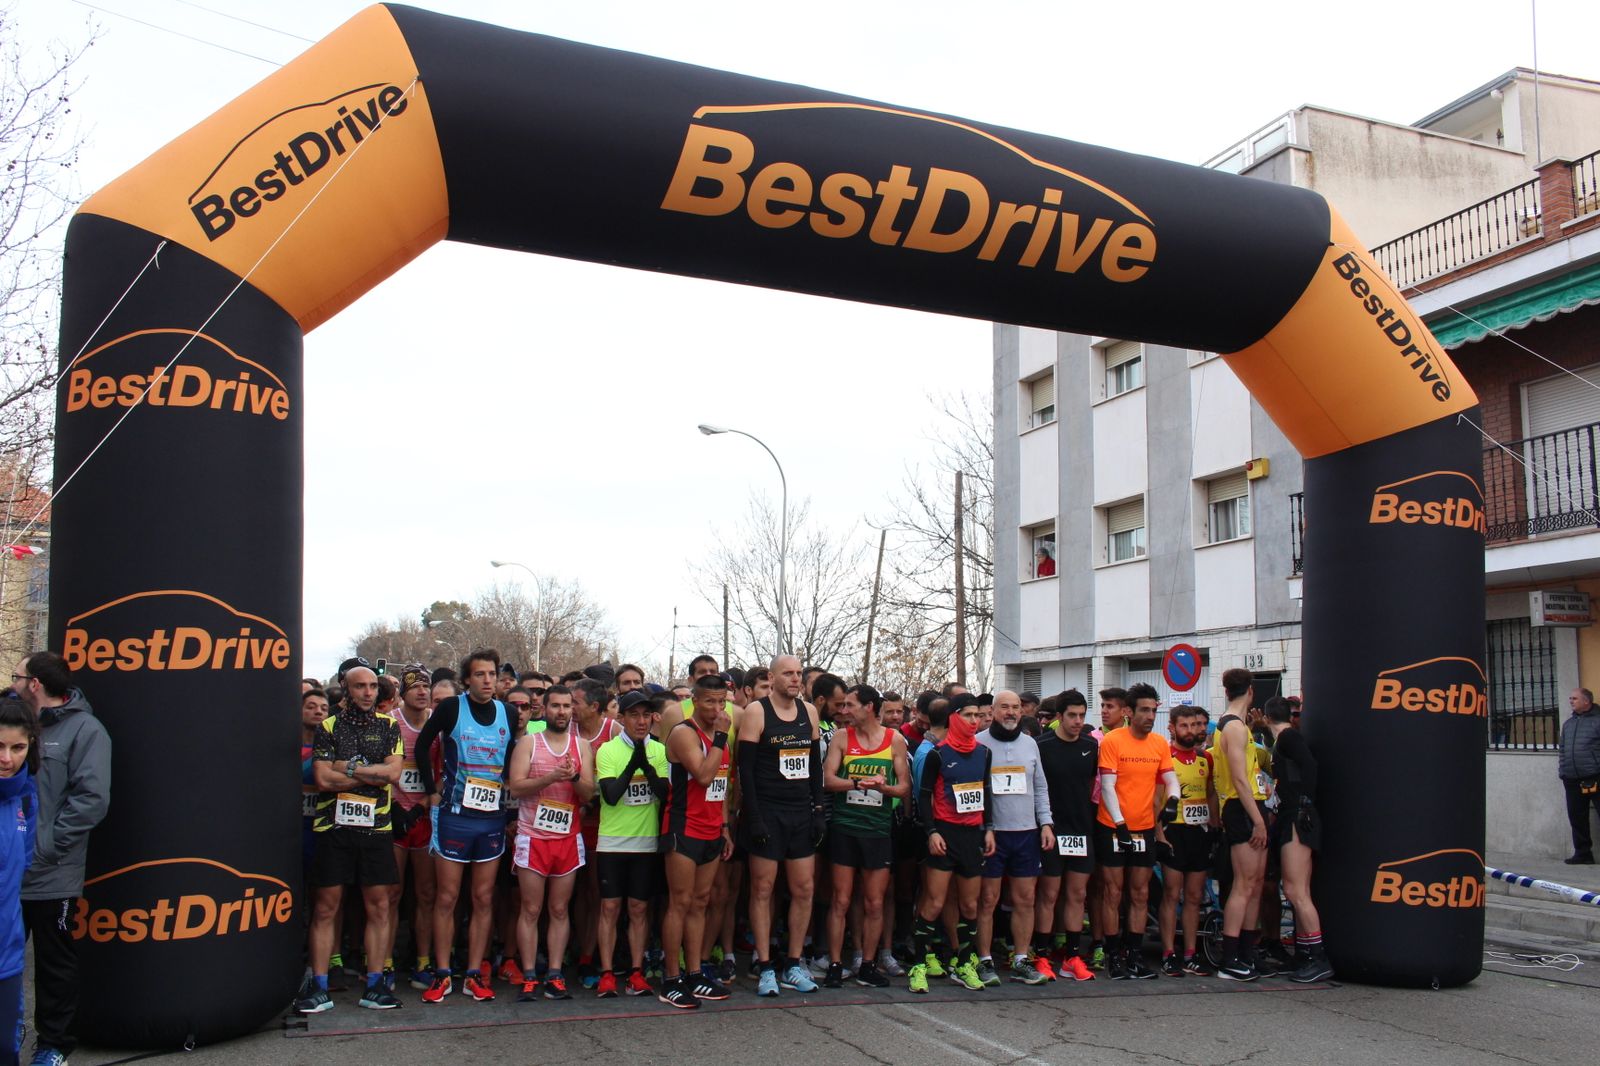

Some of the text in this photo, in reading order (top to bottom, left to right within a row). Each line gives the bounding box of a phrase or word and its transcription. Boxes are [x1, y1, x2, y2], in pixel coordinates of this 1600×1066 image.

[191, 86, 408, 242] BestDrive
[661, 124, 1157, 283] BestDrive
[1332, 252, 1451, 402] BestDrive
[66, 364, 291, 421] BestDrive
[1368, 494, 1487, 534] BestDri
[62, 627, 291, 672] BestDrive
[1244, 653, 1263, 668] 132
[783, 757, 806, 771] 1981
[712, 778, 726, 793] 1794
[1006, 774, 1012, 787] 7
[470, 786, 496, 804] 1735
[958, 790, 981, 805] 1959
[340, 801, 371, 818] 1589
[538, 807, 570, 826] 2094
[1185, 805, 1208, 818] 2296
[1060, 836, 1084, 849] 2264
[71, 888, 293, 943] BestDrive
